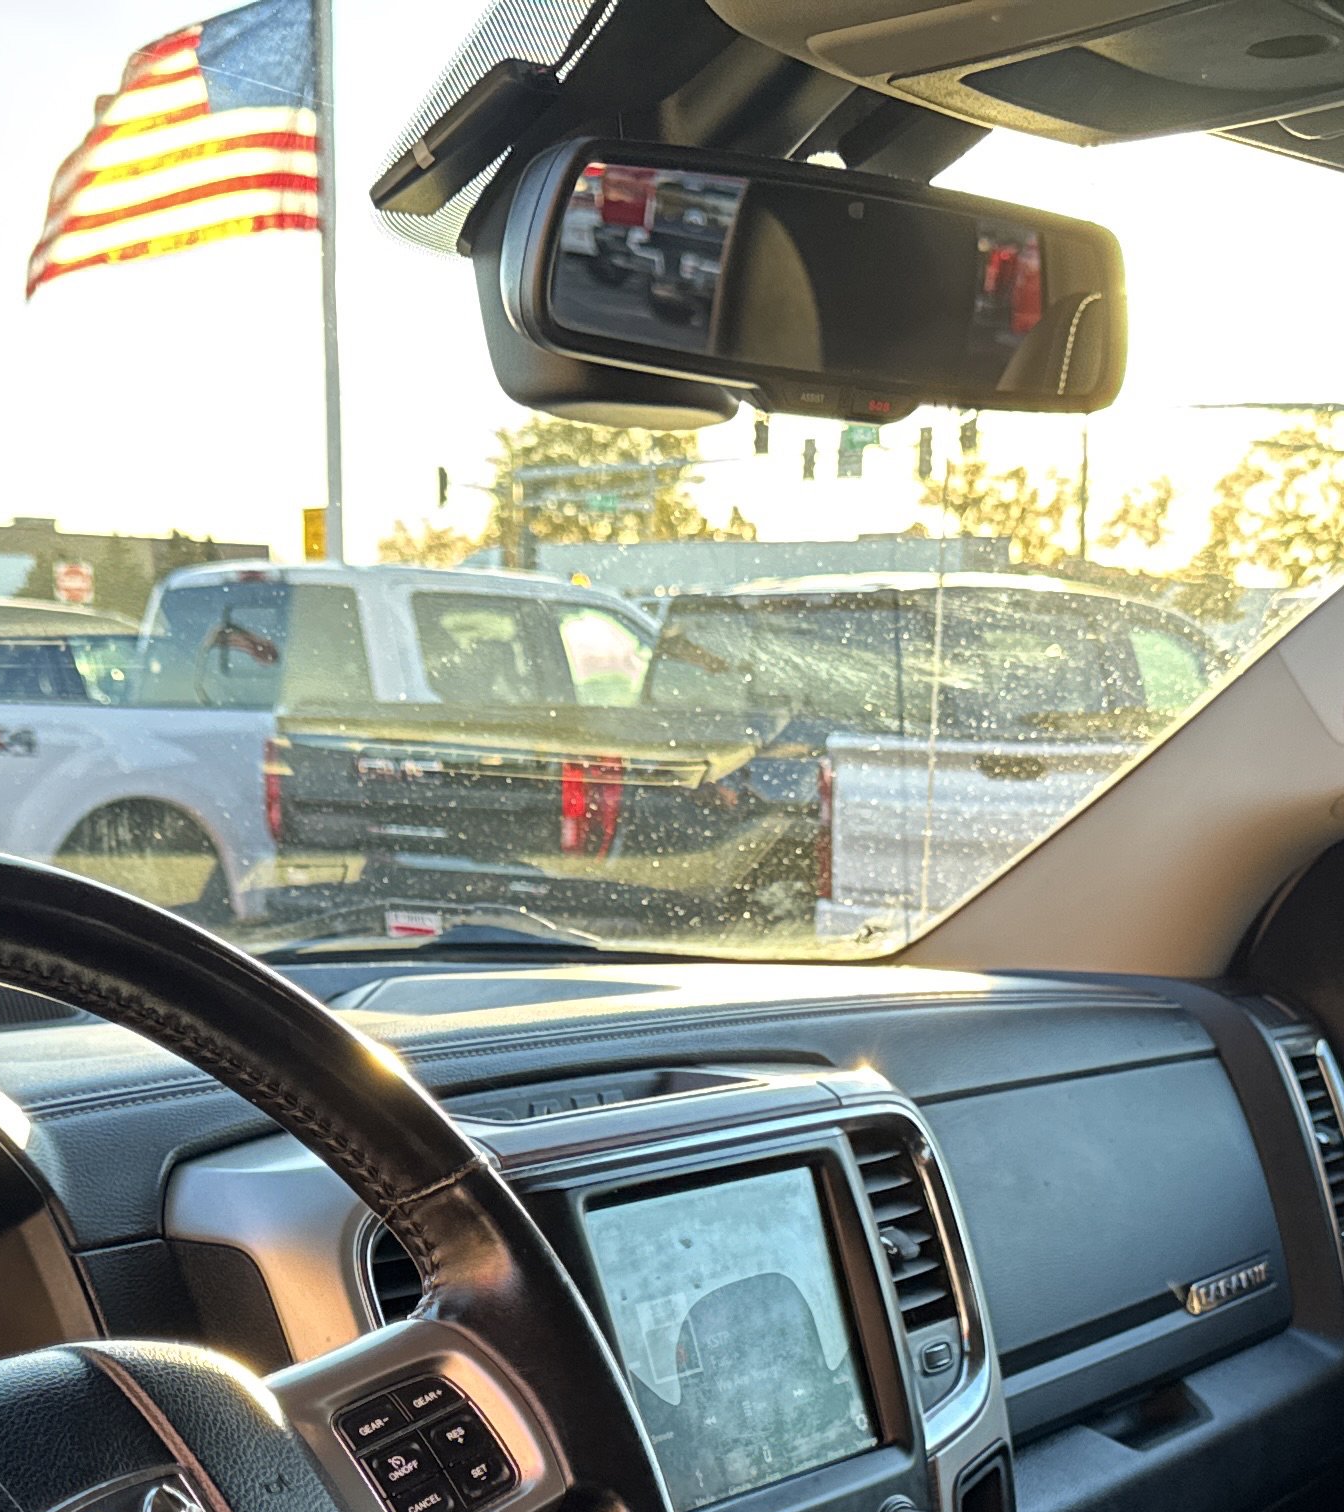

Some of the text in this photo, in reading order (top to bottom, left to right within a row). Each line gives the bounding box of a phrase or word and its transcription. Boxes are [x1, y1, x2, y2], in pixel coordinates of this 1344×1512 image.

[868, 400, 891, 412] SOS
[446, 1426, 465, 1442] RES
[388, 1459, 419, 1481] ON/OFF
[470, 1463, 488, 1479] SET
